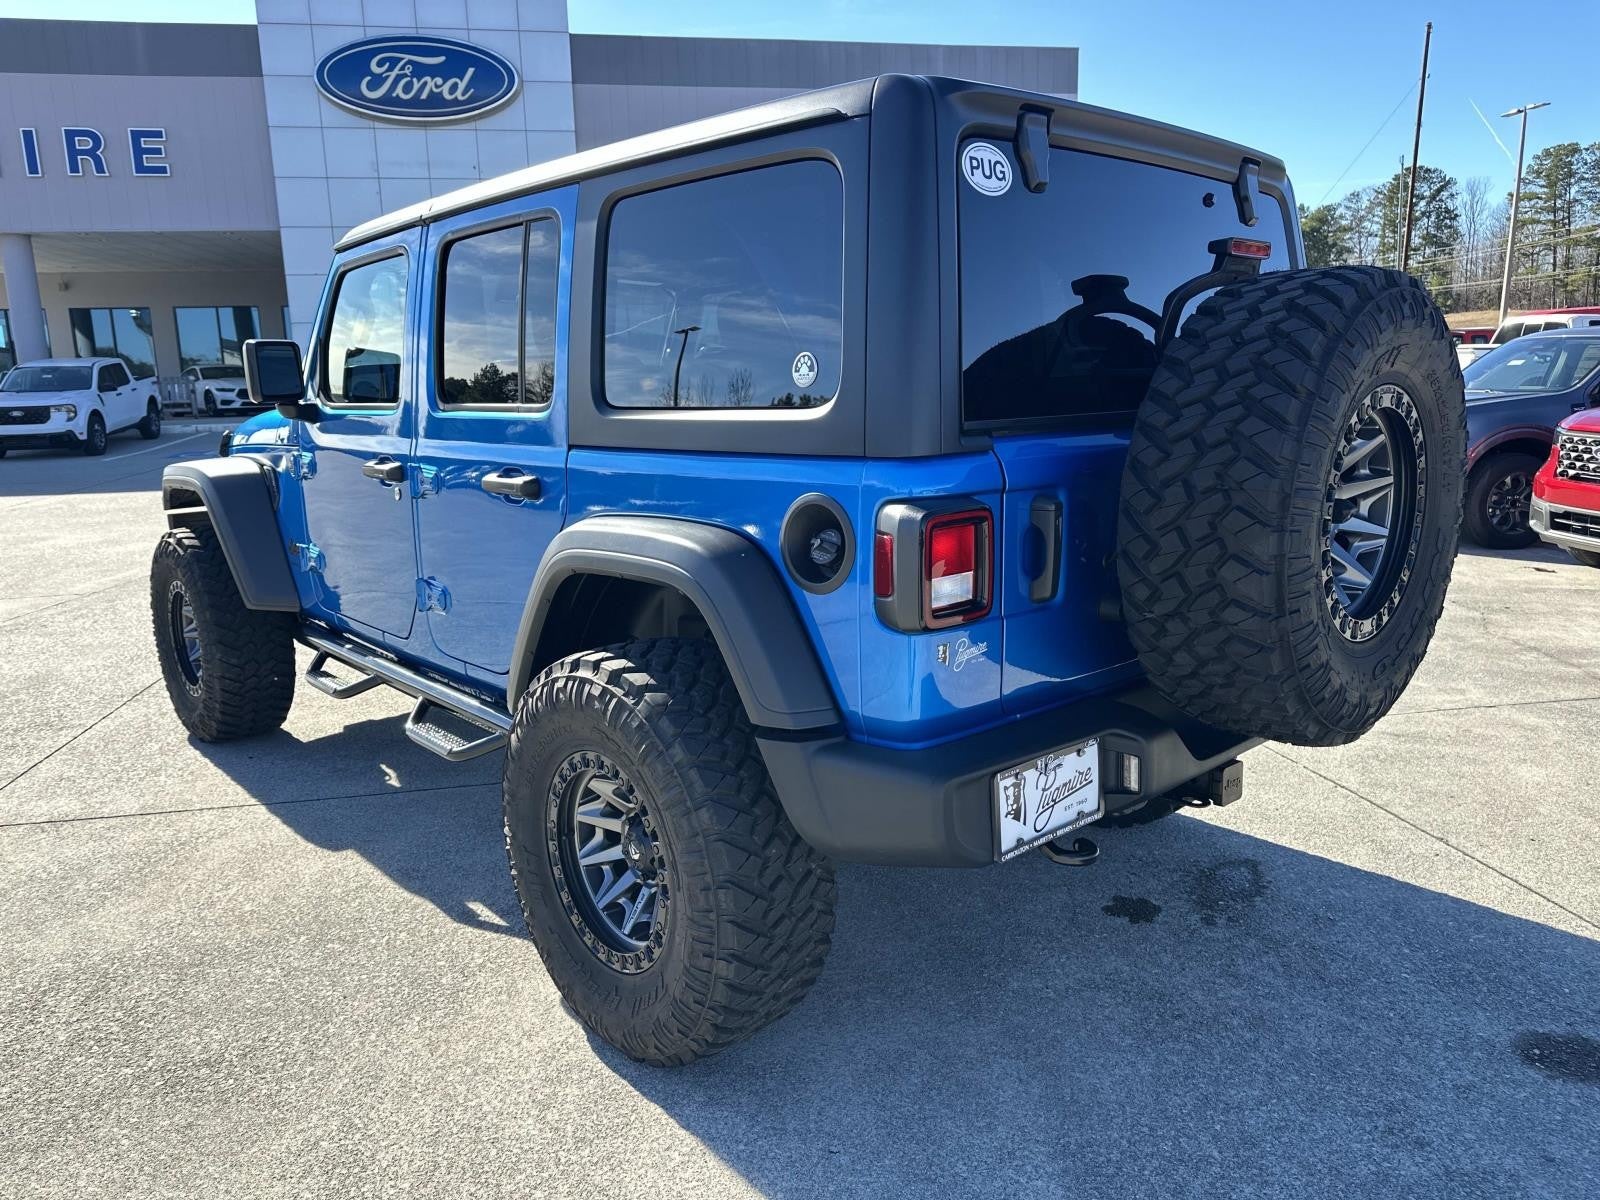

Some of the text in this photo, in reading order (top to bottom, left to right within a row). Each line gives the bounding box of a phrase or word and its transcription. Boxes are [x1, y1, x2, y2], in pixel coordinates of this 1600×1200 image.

[360, 52, 476, 101] Ford
[19, 127, 171, 177] IRE
[968, 155, 1007, 182] PUG
[1034, 763, 1093, 833] Pugmire
